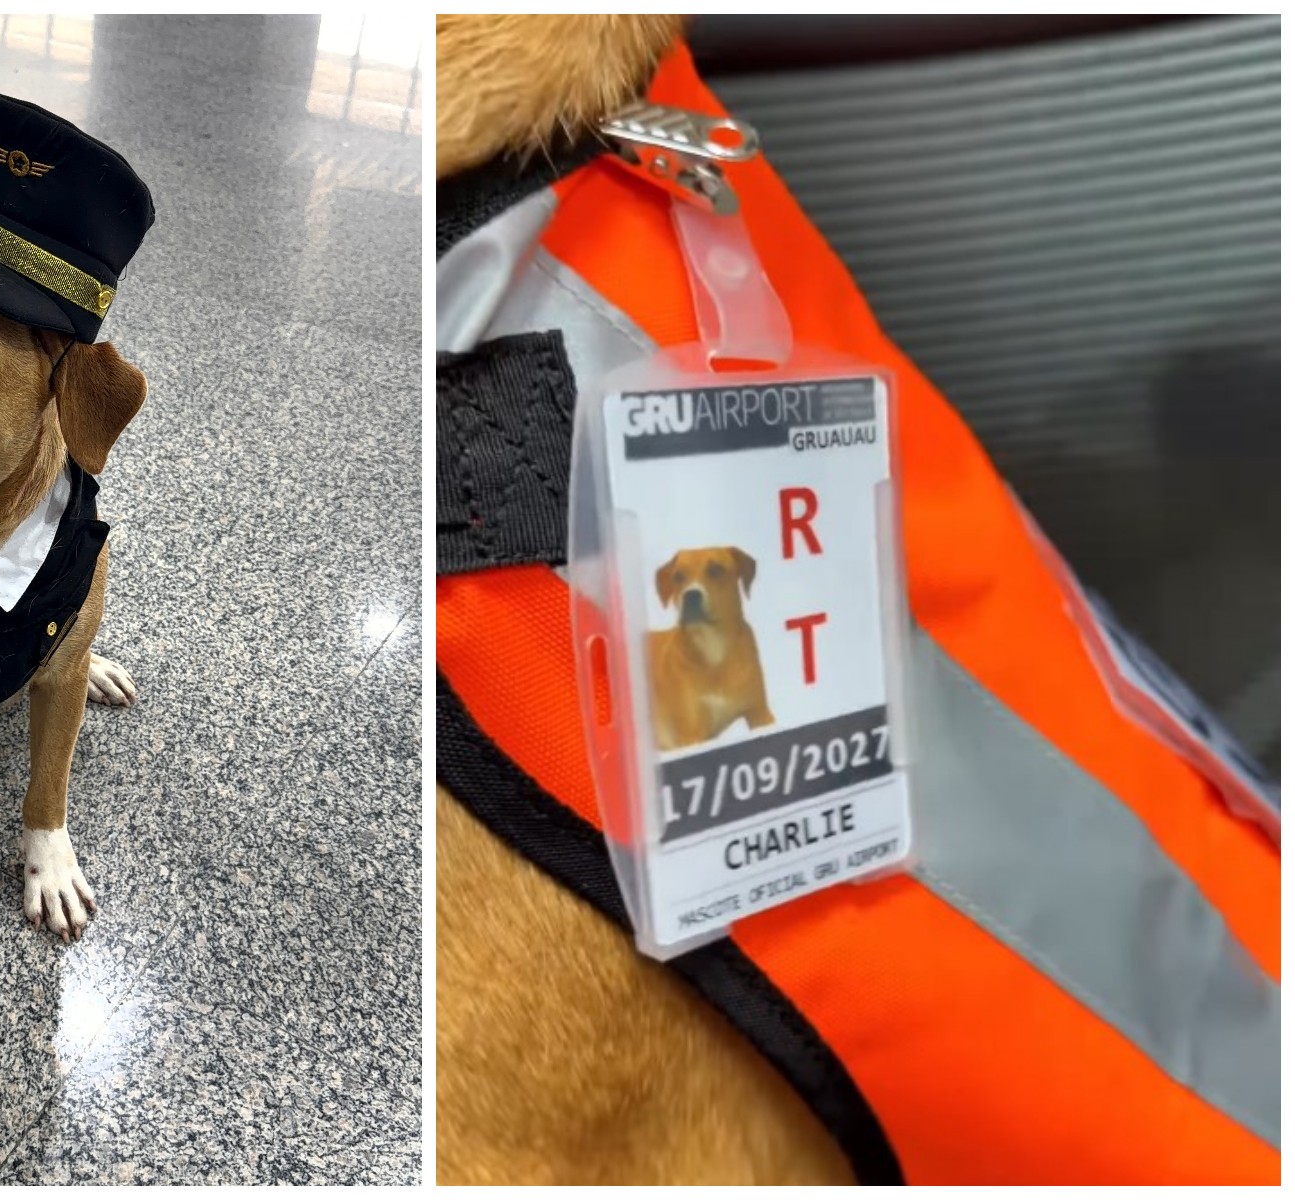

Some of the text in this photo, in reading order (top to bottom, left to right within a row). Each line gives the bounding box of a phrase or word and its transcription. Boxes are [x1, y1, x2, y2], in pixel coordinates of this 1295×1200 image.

[793, 425, 876, 451] GRUAUAU
[779, 486, 823, 560] R
[785, 612, 828, 685] T
[661, 725, 889, 823] 17/09/2027
[724, 803, 855, 870] CHARLIE
[677, 838, 899, 929] MASCOTE OFICIAL GRU AIRPORT
